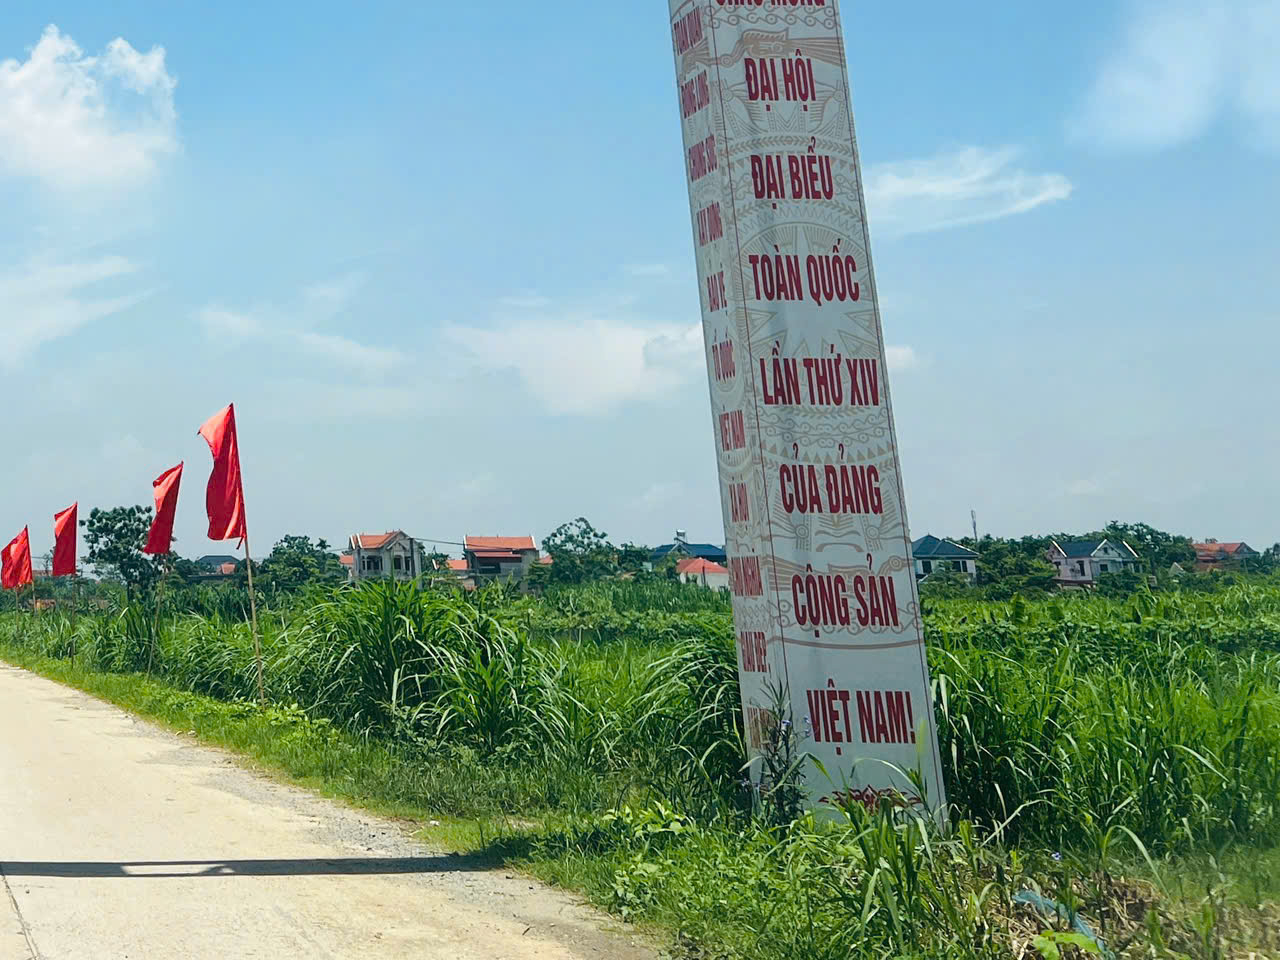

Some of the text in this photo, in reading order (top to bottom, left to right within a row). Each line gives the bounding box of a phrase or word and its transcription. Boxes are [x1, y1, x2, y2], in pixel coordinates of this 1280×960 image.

[745, 58, 779, 111] ĐẠI
[782, 48, 816, 111] HỘI
[750, 155, 785, 209] ĐẠI
[788, 136, 833, 201] BIỂU
[749, 238, 859, 306] TOÀN QUỐC
[760, 340, 879, 406] LẦN THỨ XIV
[780, 443, 883, 514] CỦA ĐẢNG
[792, 563, 850, 638] CỘNG
[855, 553, 898, 627] SẢN
[806, 678, 852, 755] VIỆT
[856, 690, 916, 744] NAM!
